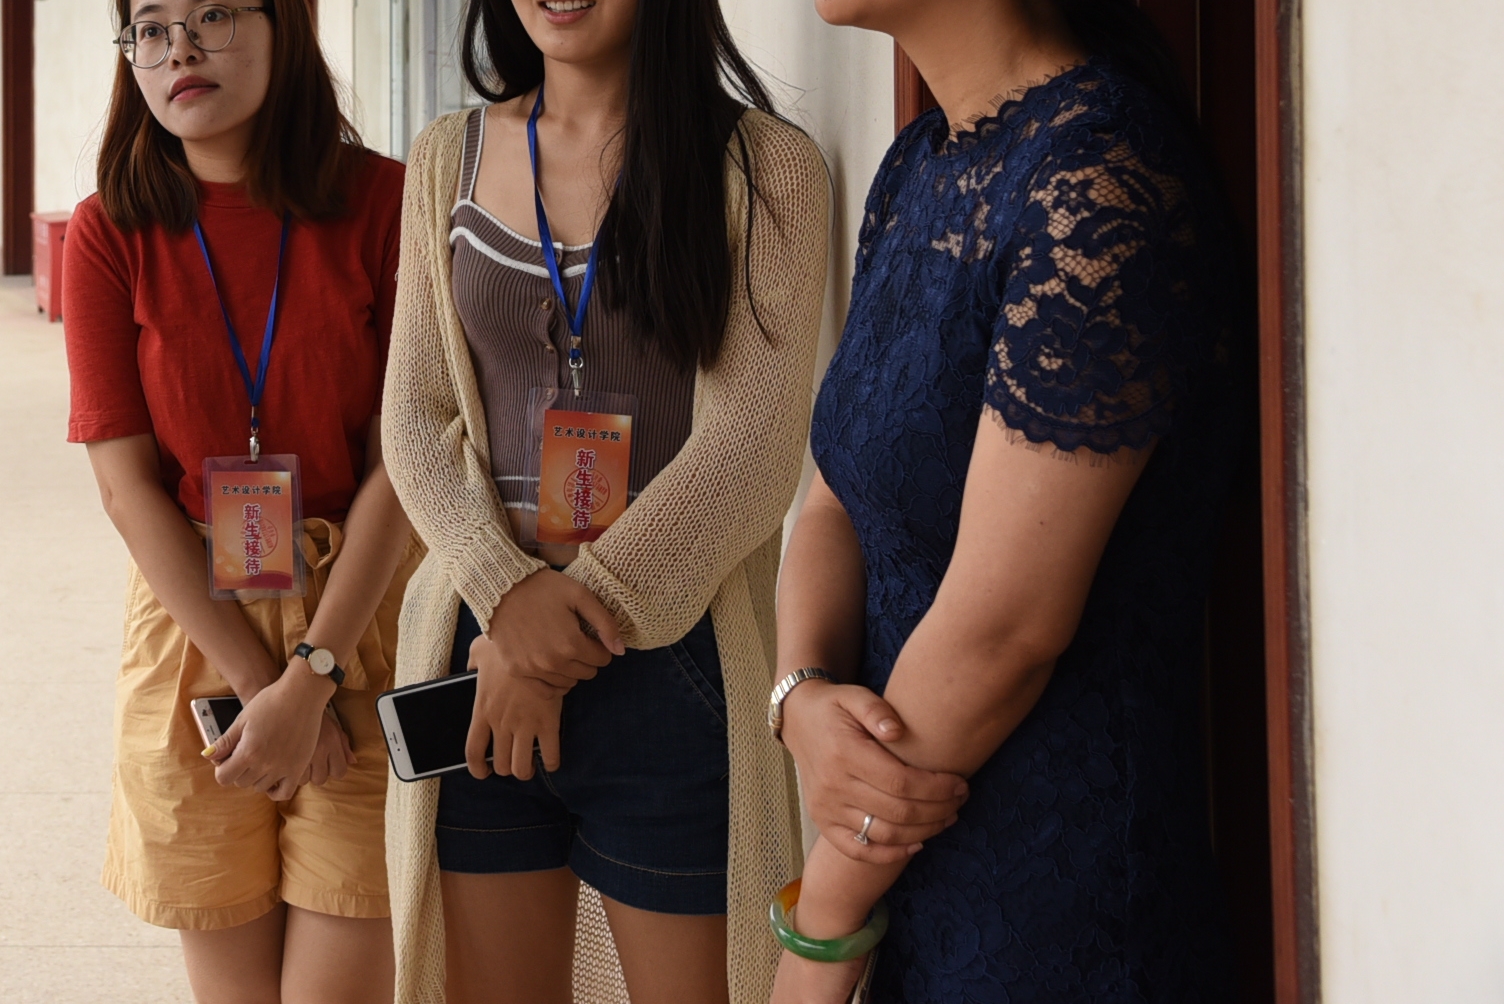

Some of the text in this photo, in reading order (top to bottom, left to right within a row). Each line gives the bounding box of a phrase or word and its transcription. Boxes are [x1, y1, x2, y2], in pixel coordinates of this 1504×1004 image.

[553, 426, 621, 442] 艺术设计学院
[221, 485, 282, 495] 艺术设计学院
[572, 448, 596, 528] 新生接待
[243, 502, 262, 575] 新生接待
